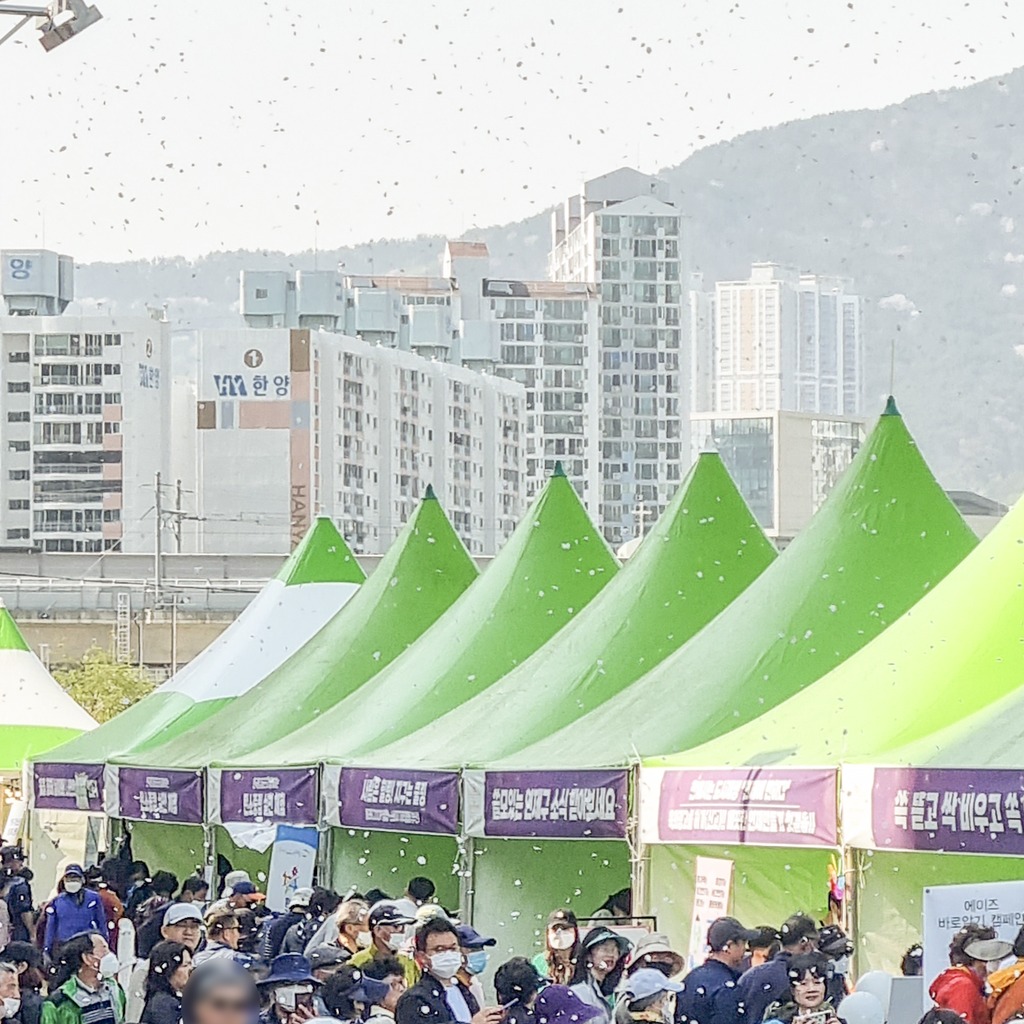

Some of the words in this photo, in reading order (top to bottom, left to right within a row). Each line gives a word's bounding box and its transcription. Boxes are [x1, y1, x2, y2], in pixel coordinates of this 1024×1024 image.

[10, 258, 33, 280] 양
[252, 374, 290, 397] 한양
[524, 788, 551, 821] 연제구
[550, 788, 568, 820] 소식
[959, 792, 1005, 833] 비우고
[964, 898, 999, 912] 에이즈
